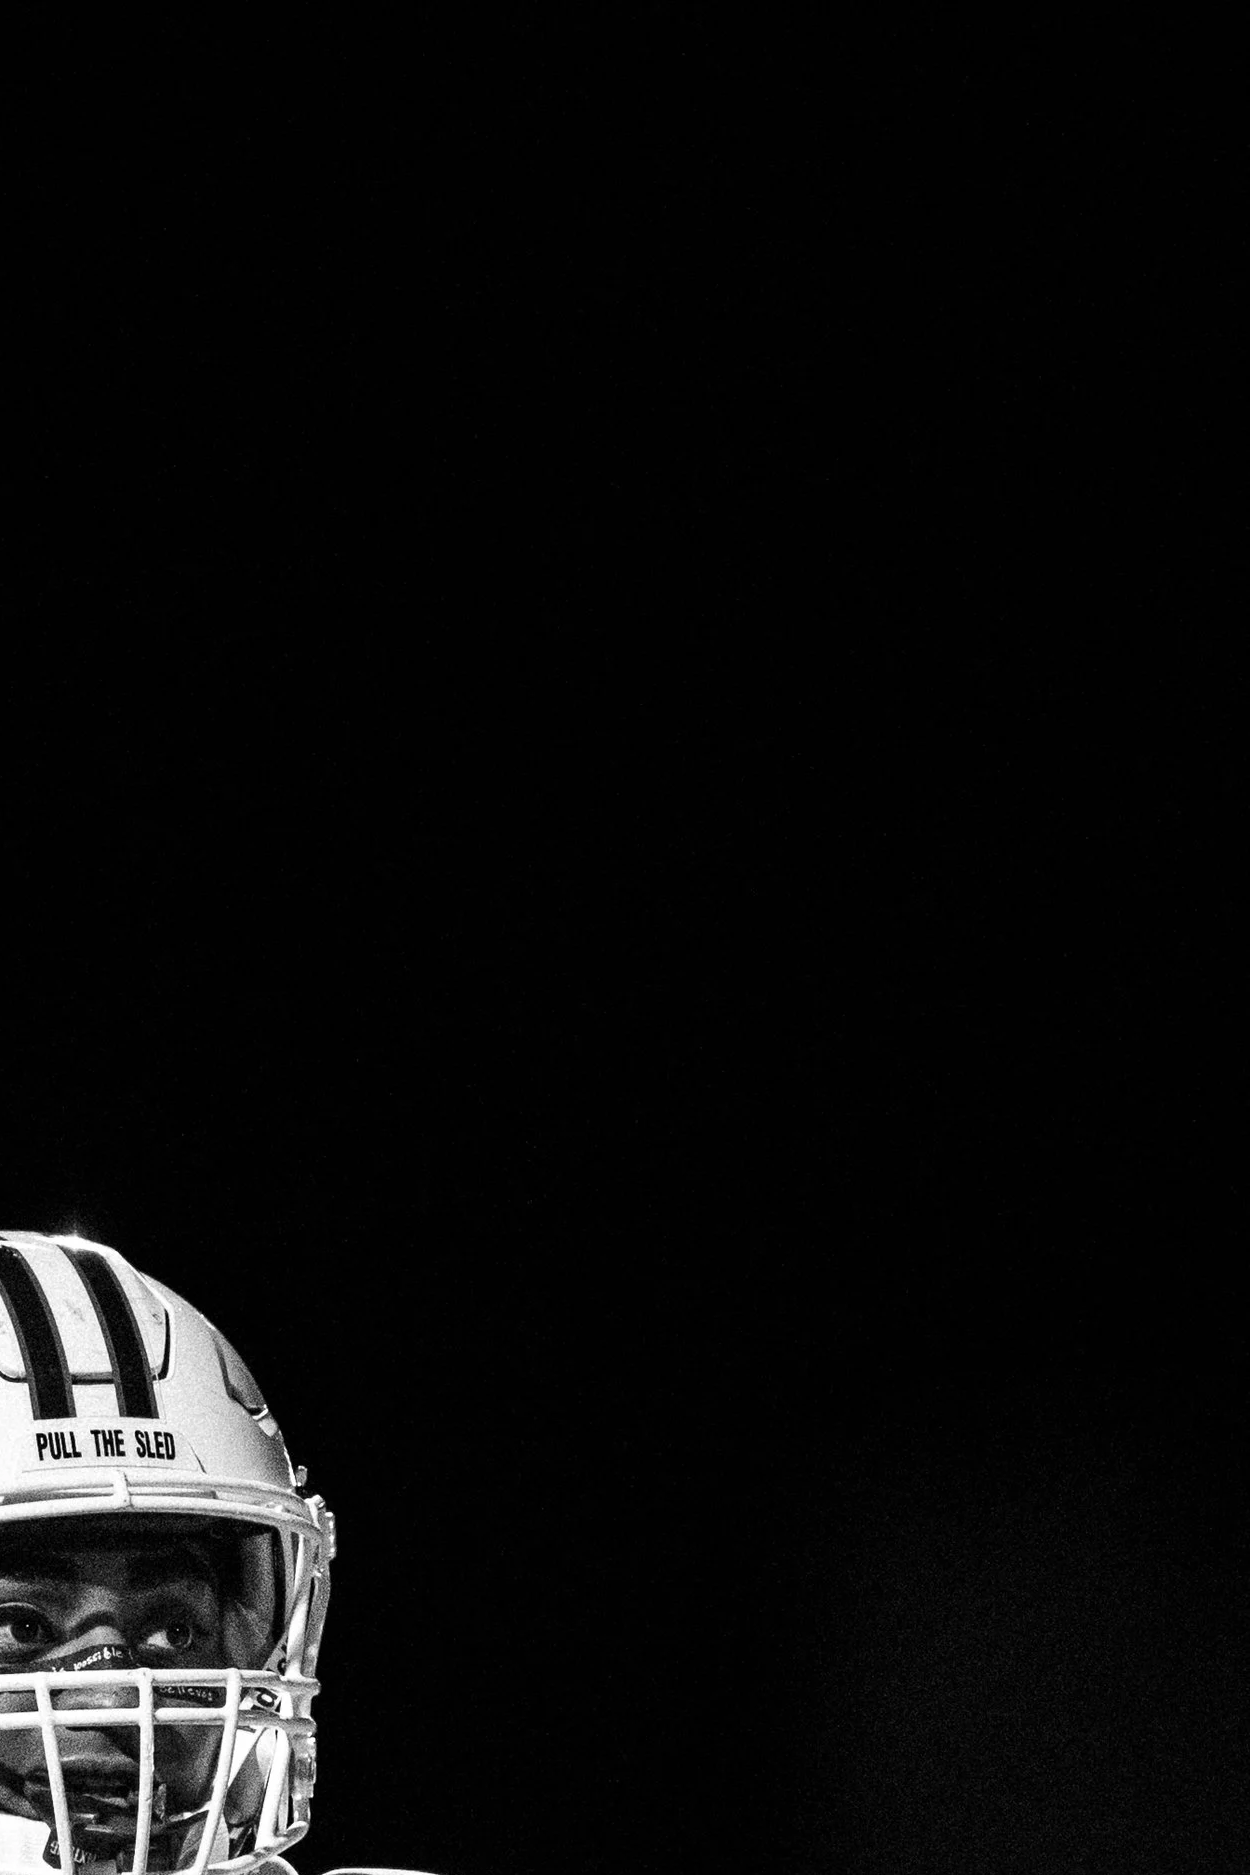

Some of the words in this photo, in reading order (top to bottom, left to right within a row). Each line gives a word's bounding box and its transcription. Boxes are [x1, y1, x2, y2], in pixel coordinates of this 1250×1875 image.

[36, 1431, 82, 1461] PULL
[90, 1429, 126, 1458] THE
[134, 1429, 176, 1460] SLED
